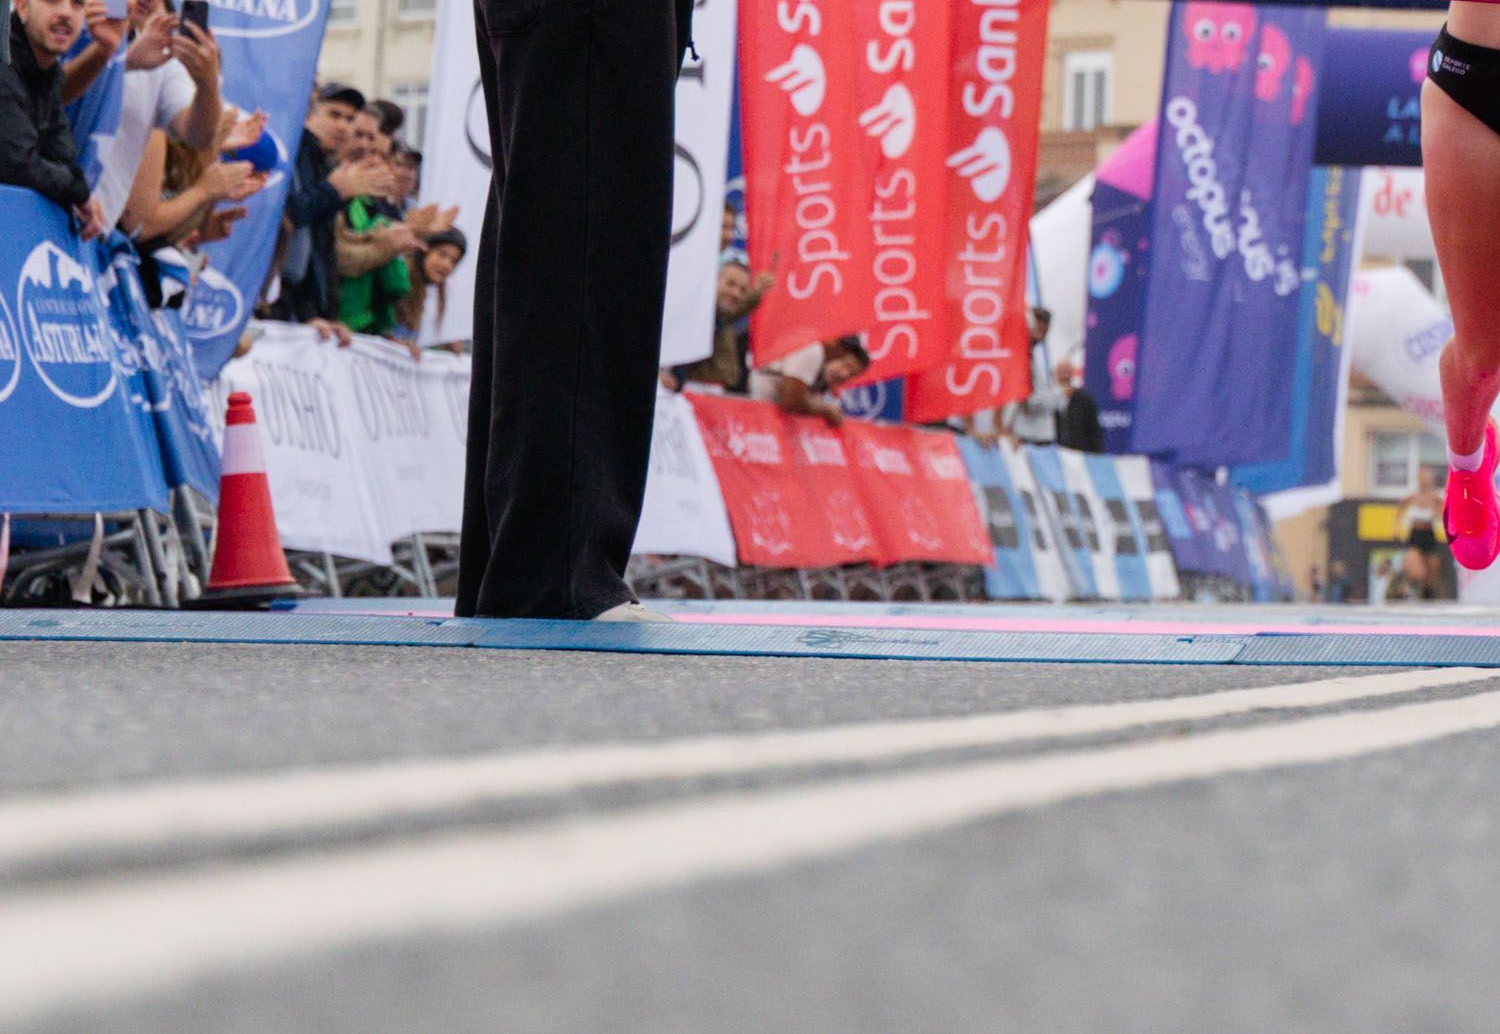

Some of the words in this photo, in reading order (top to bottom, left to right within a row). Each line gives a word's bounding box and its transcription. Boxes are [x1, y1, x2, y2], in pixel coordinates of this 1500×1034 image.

[1442, 62, 1466, 76] GALEGO
[784, 122, 851, 300] Sports
[858, 168, 932, 362] Sports
[946, 212, 1012, 397] Sports
